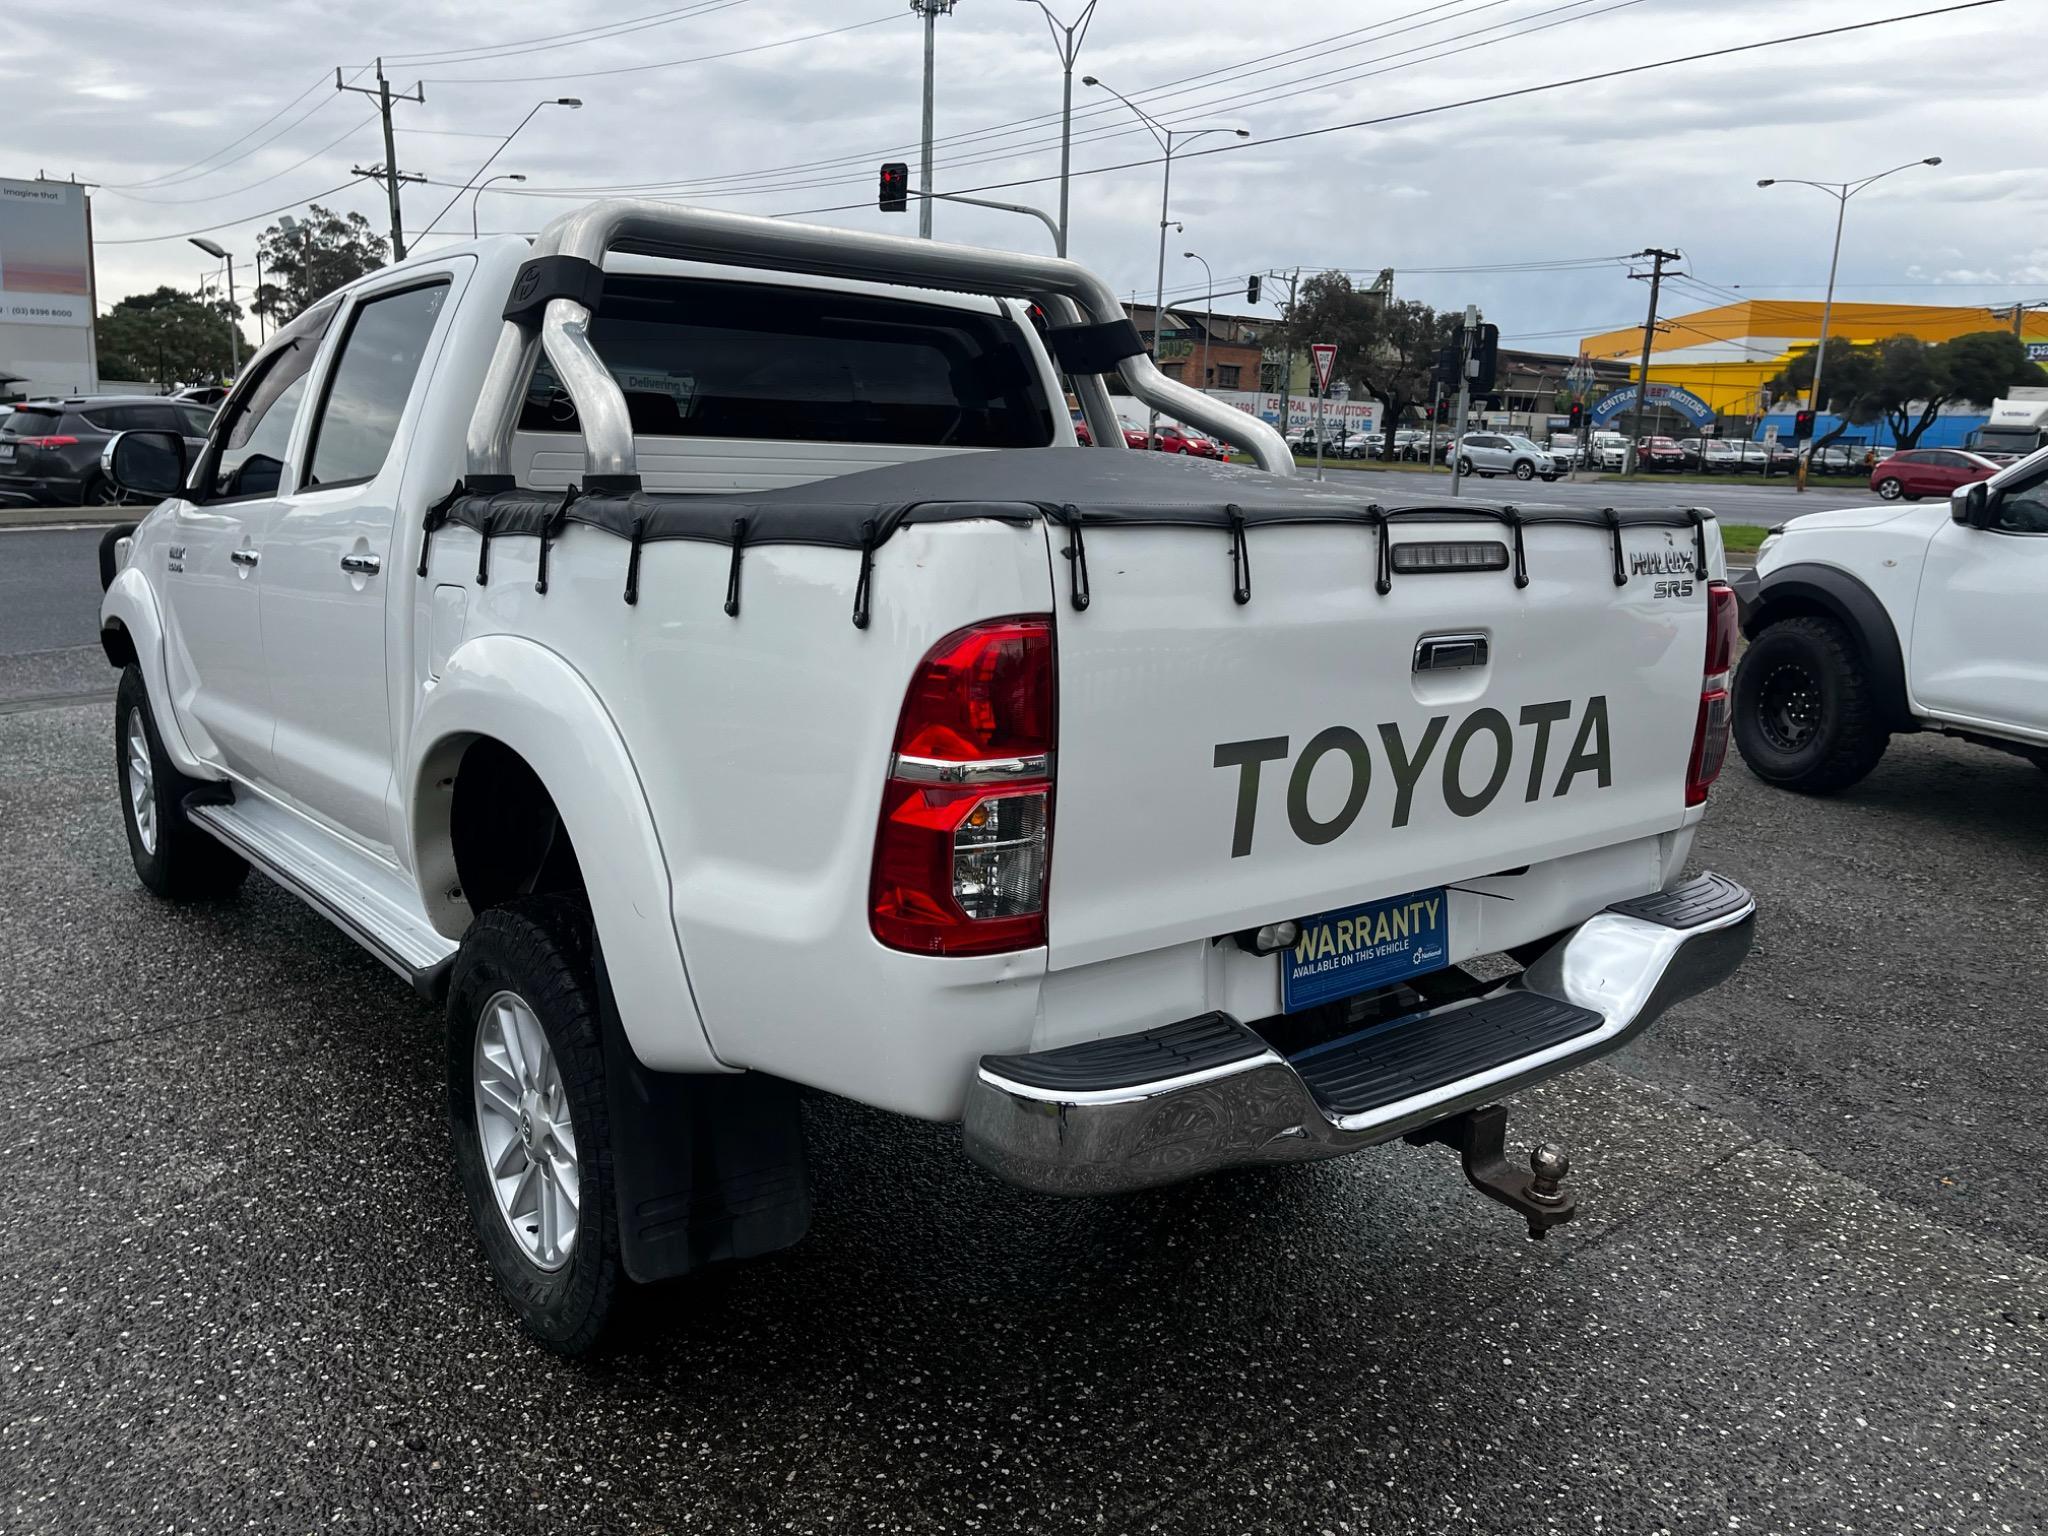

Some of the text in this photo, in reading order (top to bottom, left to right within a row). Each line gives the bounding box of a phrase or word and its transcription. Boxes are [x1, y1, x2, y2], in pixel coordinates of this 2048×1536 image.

[3, 187, 39, 199] Imagine
[1267, 398, 1373, 418] CERAL WST MOTORS
[1596, 389, 1638, 415] CENTRAL
[1670, 390, 1707, 418] MOTORS
[1329, 418, 1346, 427] CAR
[1630, 551, 1696, 576] HILUX
[1213, 695, 1612, 859] TOYOTA
[1294, 898, 1440, 965] WARRANTY
[1292, 955, 1340, 980] AVAILABLE
[1341, 949, 1354, 967] ON
[1355, 947, 1375, 964] THIS
[1375, 939, 1410, 958] VEHICLE
